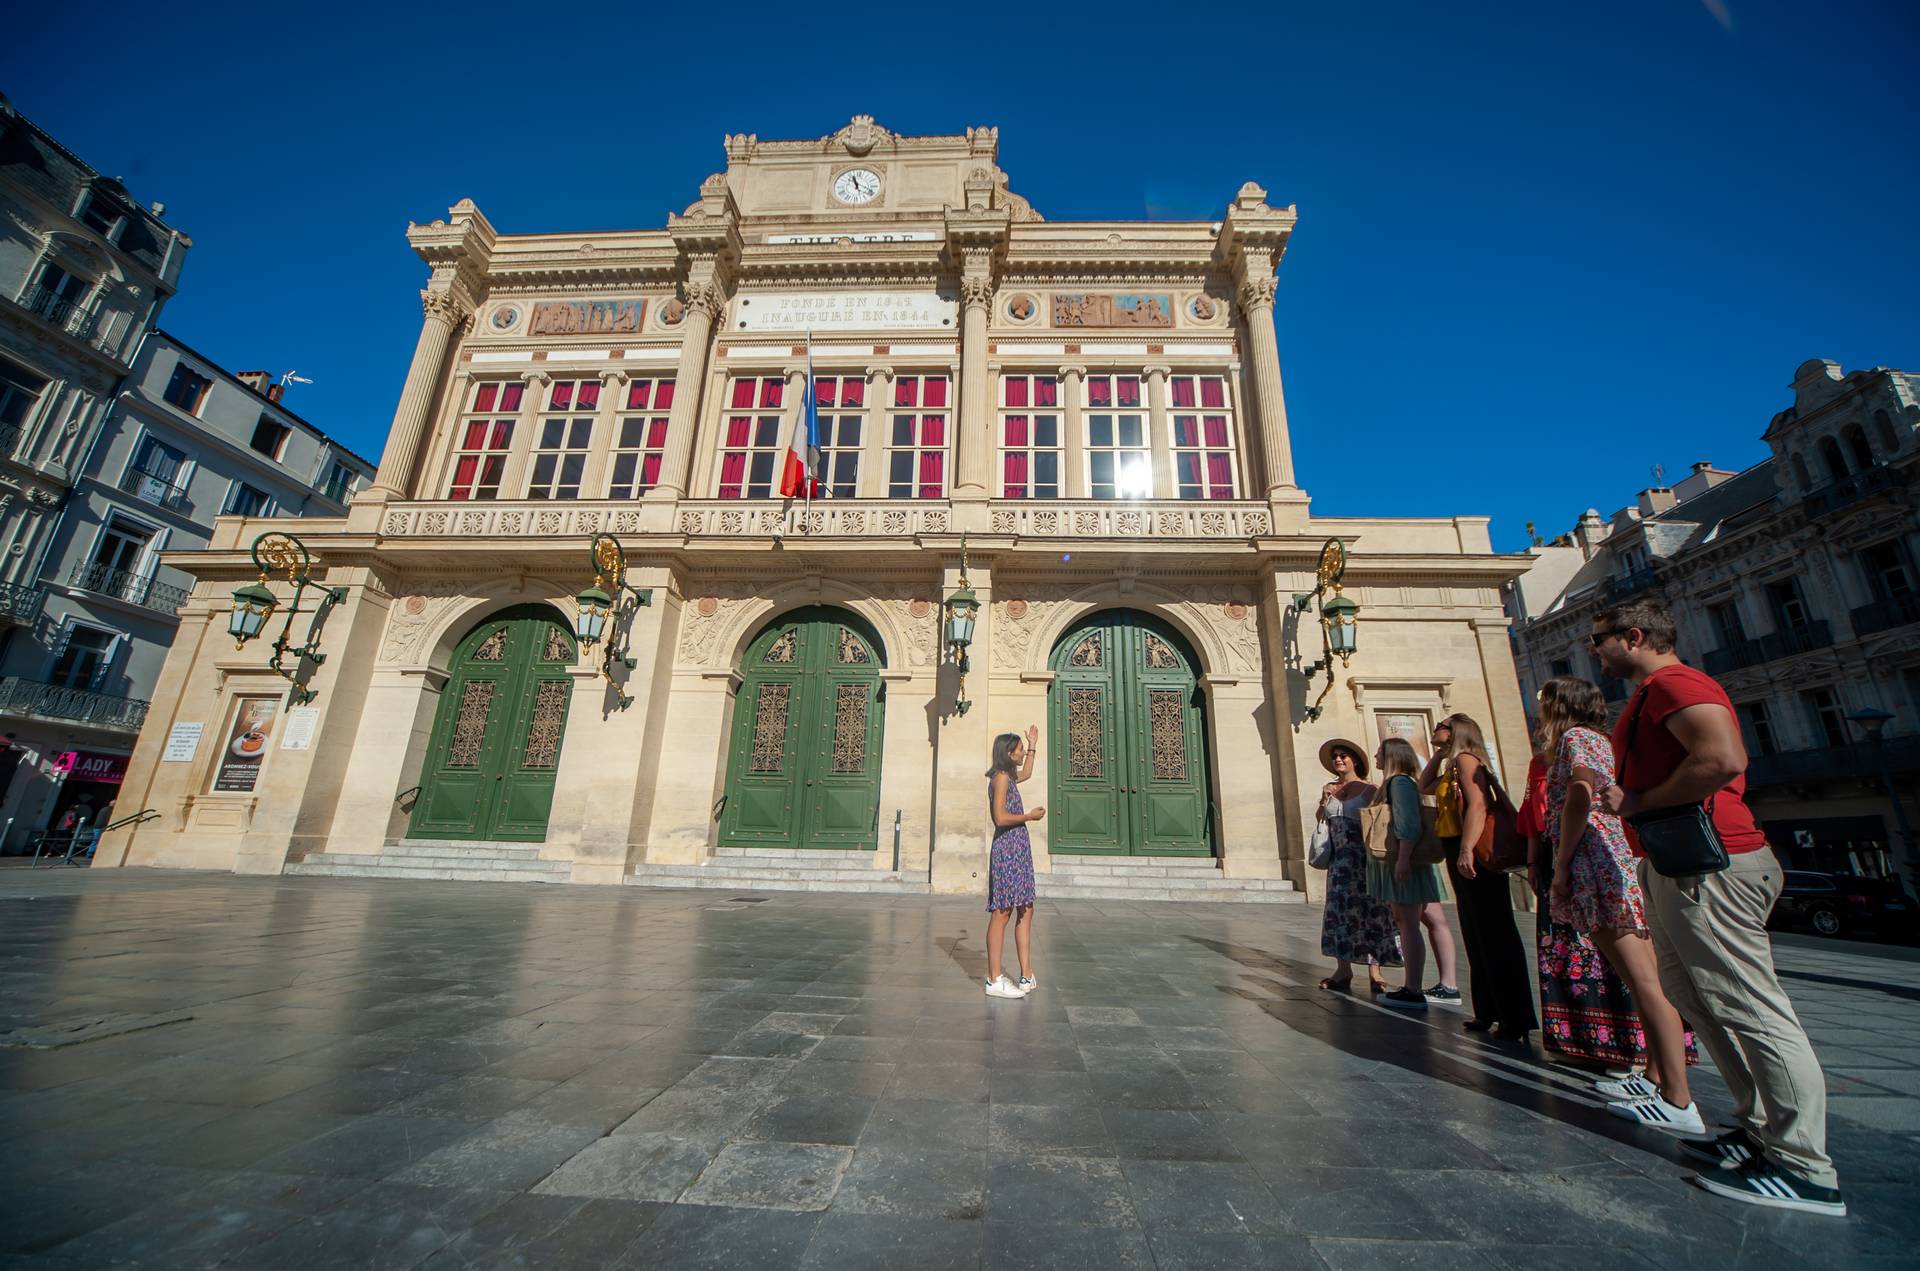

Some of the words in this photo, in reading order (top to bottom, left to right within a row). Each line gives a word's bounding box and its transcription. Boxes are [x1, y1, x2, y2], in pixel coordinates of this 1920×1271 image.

[790, 234, 913, 245] THETRE
[780, 295, 836, 309] FONDÉ
[845, 296, 868, 307] EN
[760, 309, 854, 323] INAUGURÉ
[862, 310, 885, 321] EN
[892, 310, 929, 321] 1844
[73, 756, 114, 773] LADY
